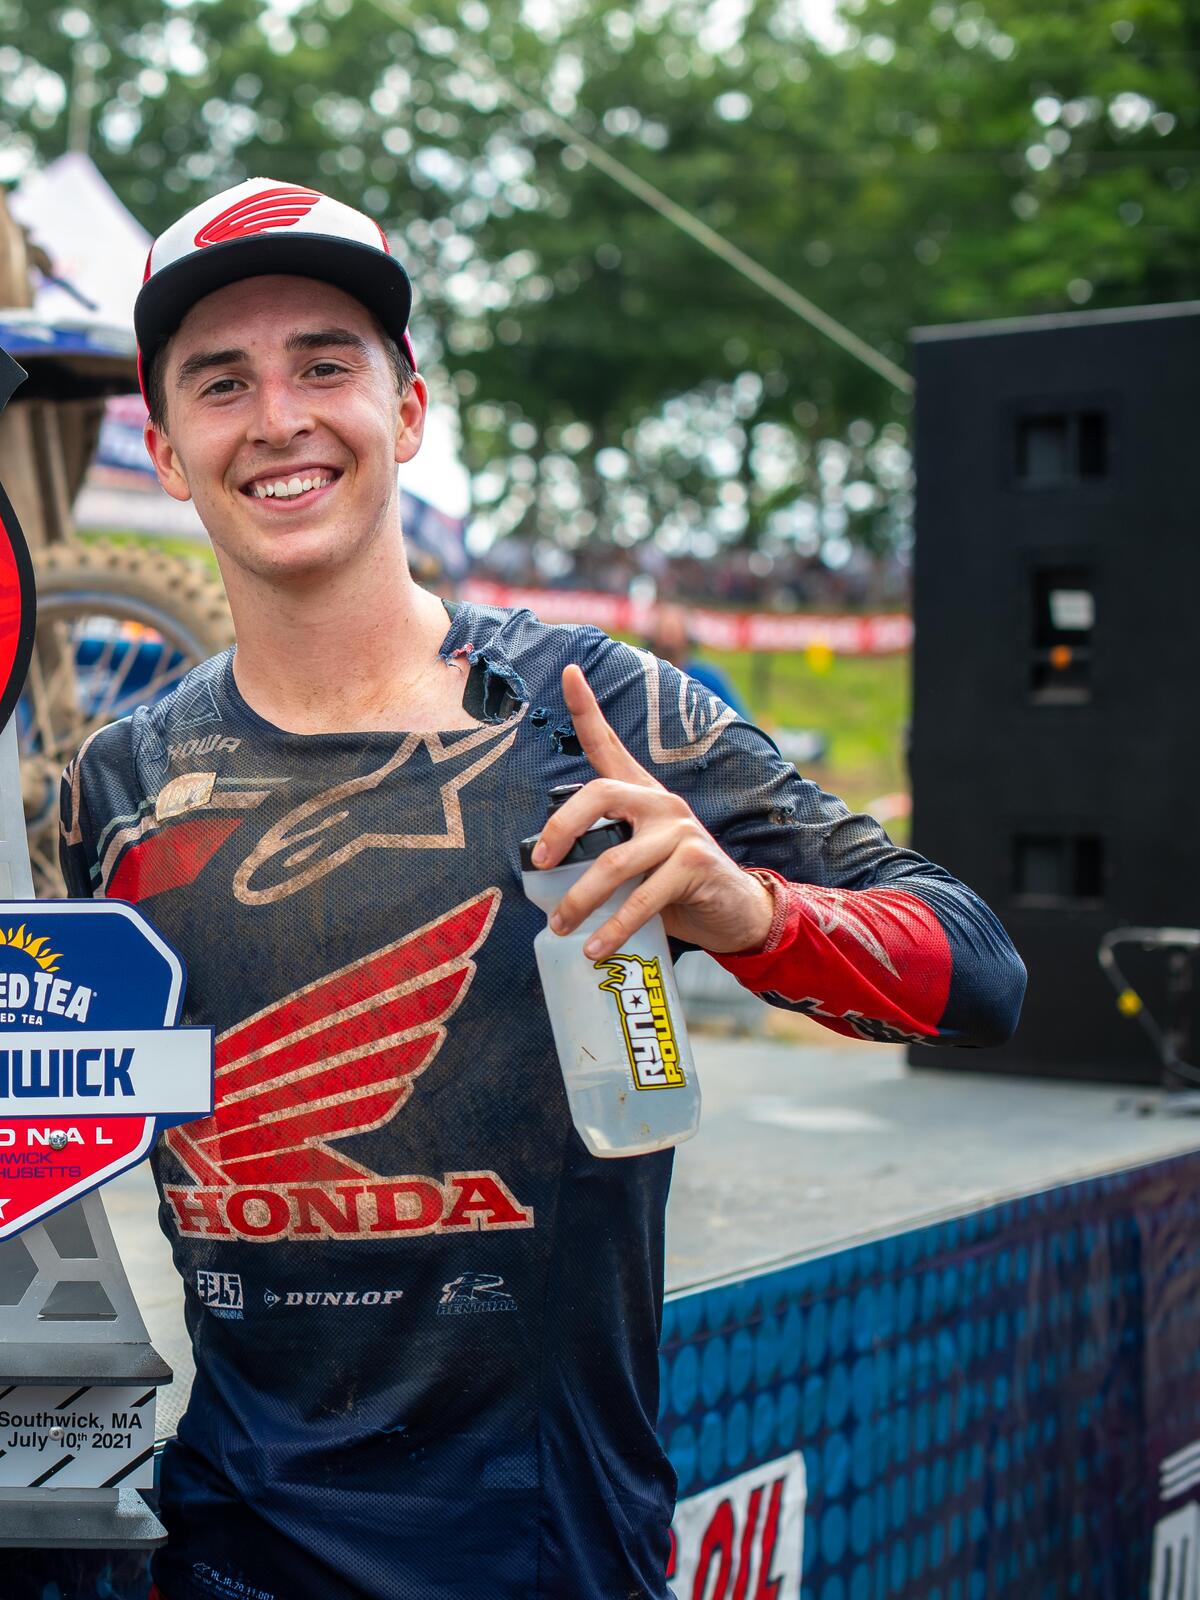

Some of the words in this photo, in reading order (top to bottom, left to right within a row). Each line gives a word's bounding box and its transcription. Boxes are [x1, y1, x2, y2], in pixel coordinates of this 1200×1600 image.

[33, 971, 93, 1024] TEA
[21, 1013, 44, 1026] TEA
[642, 965, 683, 1084] POWER
[620, 987, 668, 1086] RYNO
[163, 1170, 535, 1242] HONDA
[284, 1289, 404, 1307] DUNLOP
[435, 1297, 519, 1316] RENTHAL
[111, 1413, 143, 1429] MA
[7, 1431, 48, 1452] July
[91, 1433, 132, 1449] 2021
